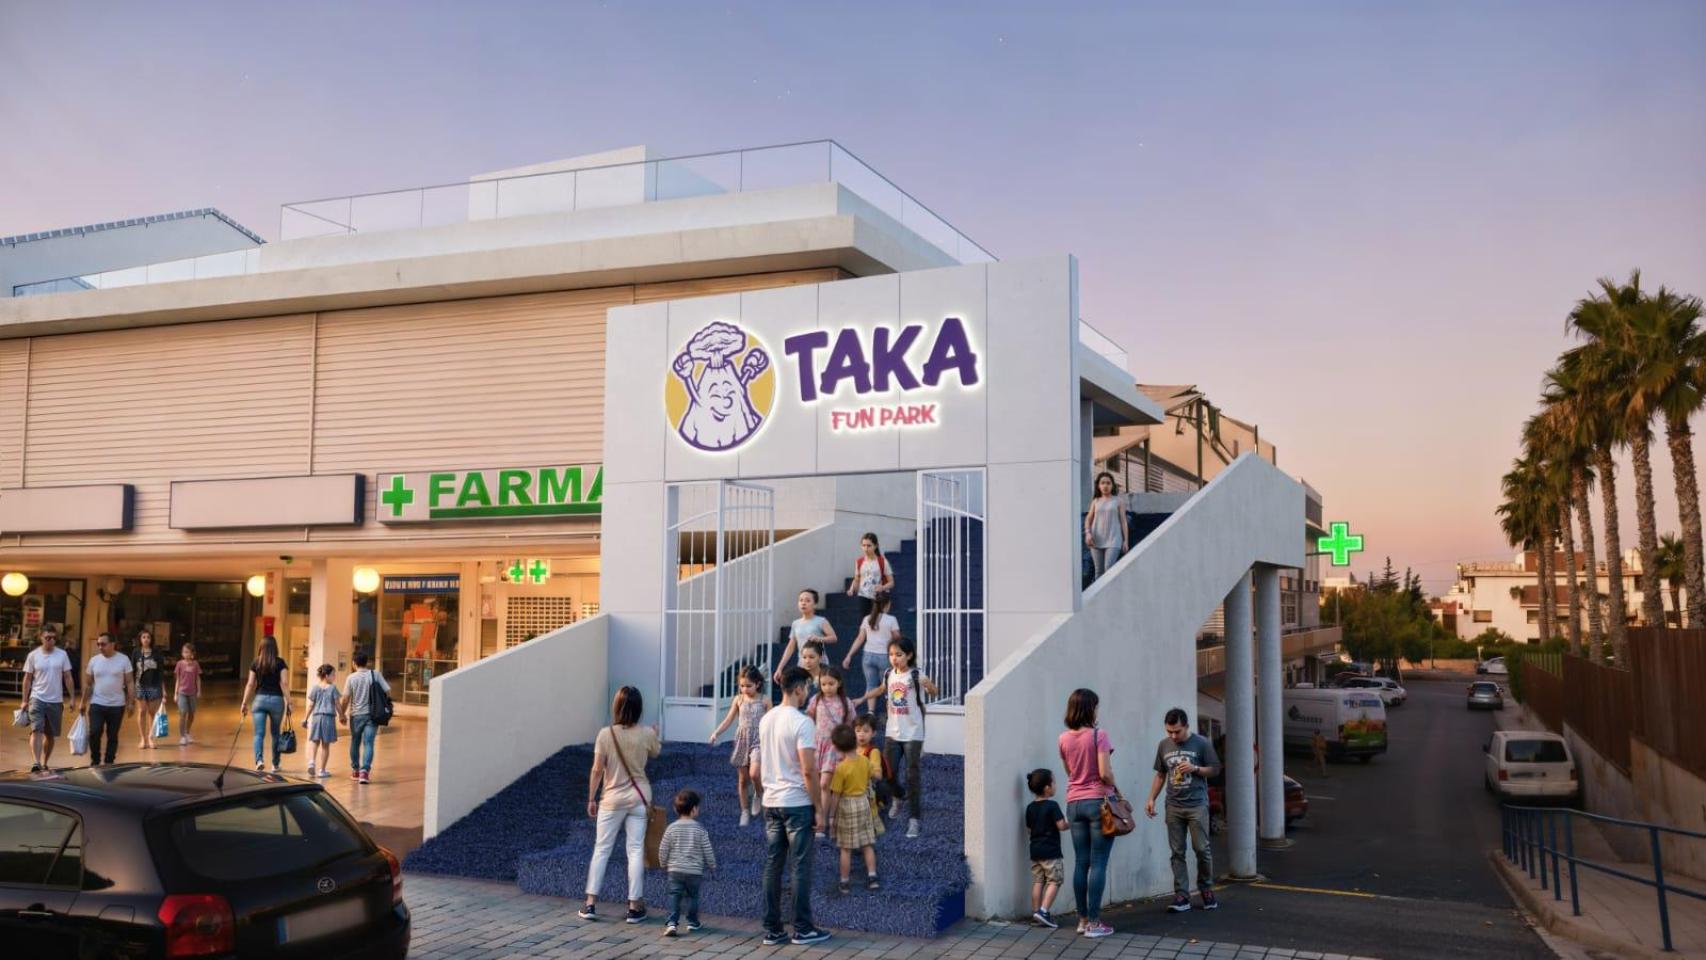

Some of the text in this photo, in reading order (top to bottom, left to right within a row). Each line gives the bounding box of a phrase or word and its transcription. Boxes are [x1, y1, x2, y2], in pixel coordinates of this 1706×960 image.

[785, 317, 979, 402] TAKA
[831, 404, 936, 430] FUN PARK
